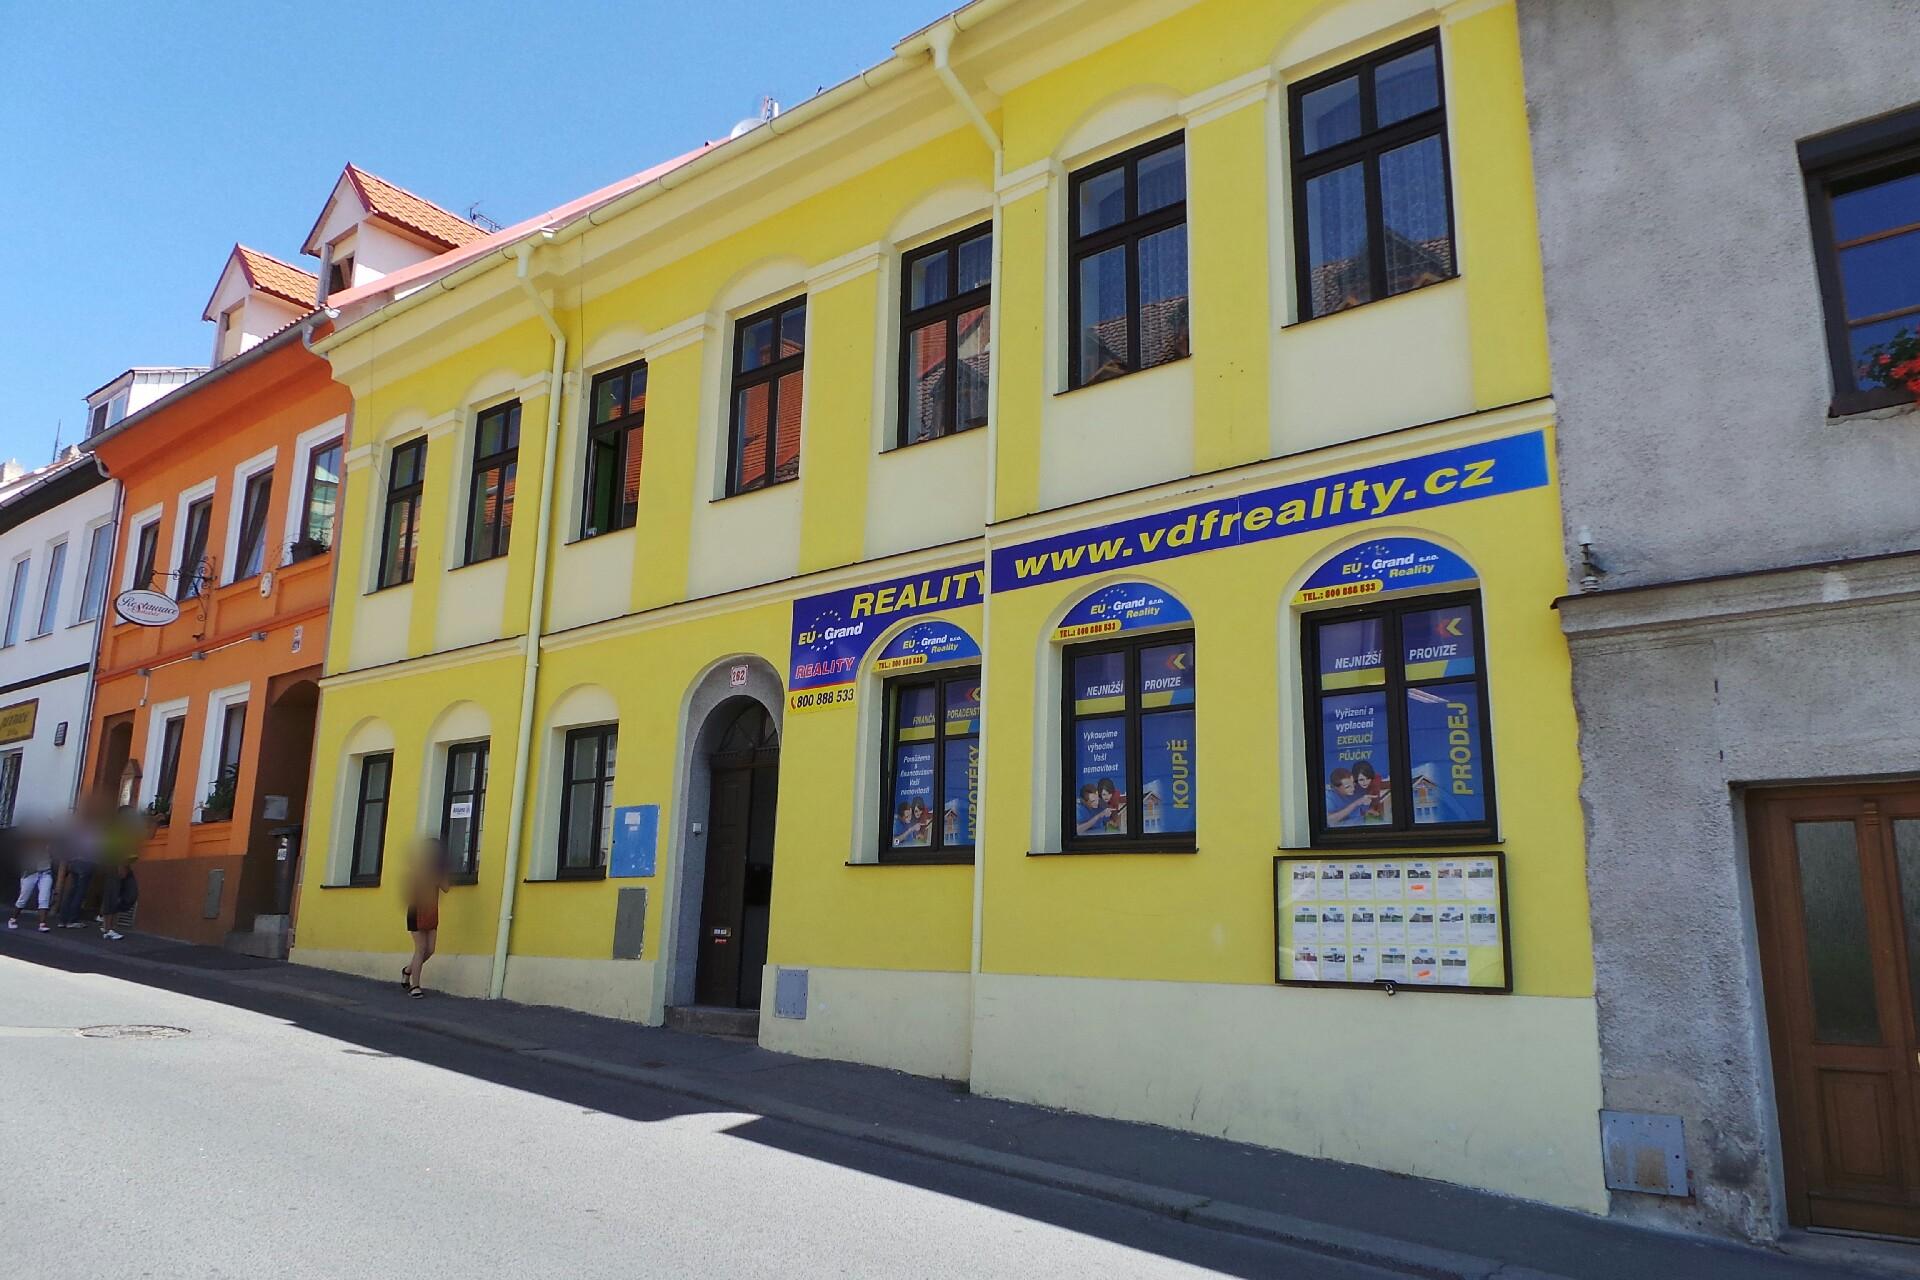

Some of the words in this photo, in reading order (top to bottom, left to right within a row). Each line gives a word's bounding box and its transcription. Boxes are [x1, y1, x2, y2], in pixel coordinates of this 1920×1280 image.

[1014, 457, 1496, 579] www.vdfreality.cz
[1342, 563, 1361, 575] EU
[1371, 553, 1414, 570] Grand
[1389, 563, 1434, 579] Reality
[1090, 603, 1106, 615] EU
[1113, 597, 1145, 611] Grand
[1126, 606, 1160, 619] Reality
[798, 630, 816, 645] EU
[824, 622, 864, 641] Grand
[902, 639, 915, 650] EU
[921, 634, 948, 647] Grand
[931, 642, 959, 654] Reality
[1335, 648, 1382, 670] NEJNIŽŠÍ
[1409, 643, 1457, 660] PROVIZE
[794, 656, 856, 680] REALITY
[1086, 679, 1124, 697] NEJNIŽŠÍ
[1145, 676, 1182, 690] PROVIZE
[797, 693, 813, 708] 800
[816, 690, 833, 705] 888
[836, 688, 854, 703] 533
[1447, 702, 1474, 795] PRODEJ
[1166, 739, 1189, 809] KOUPĚ
